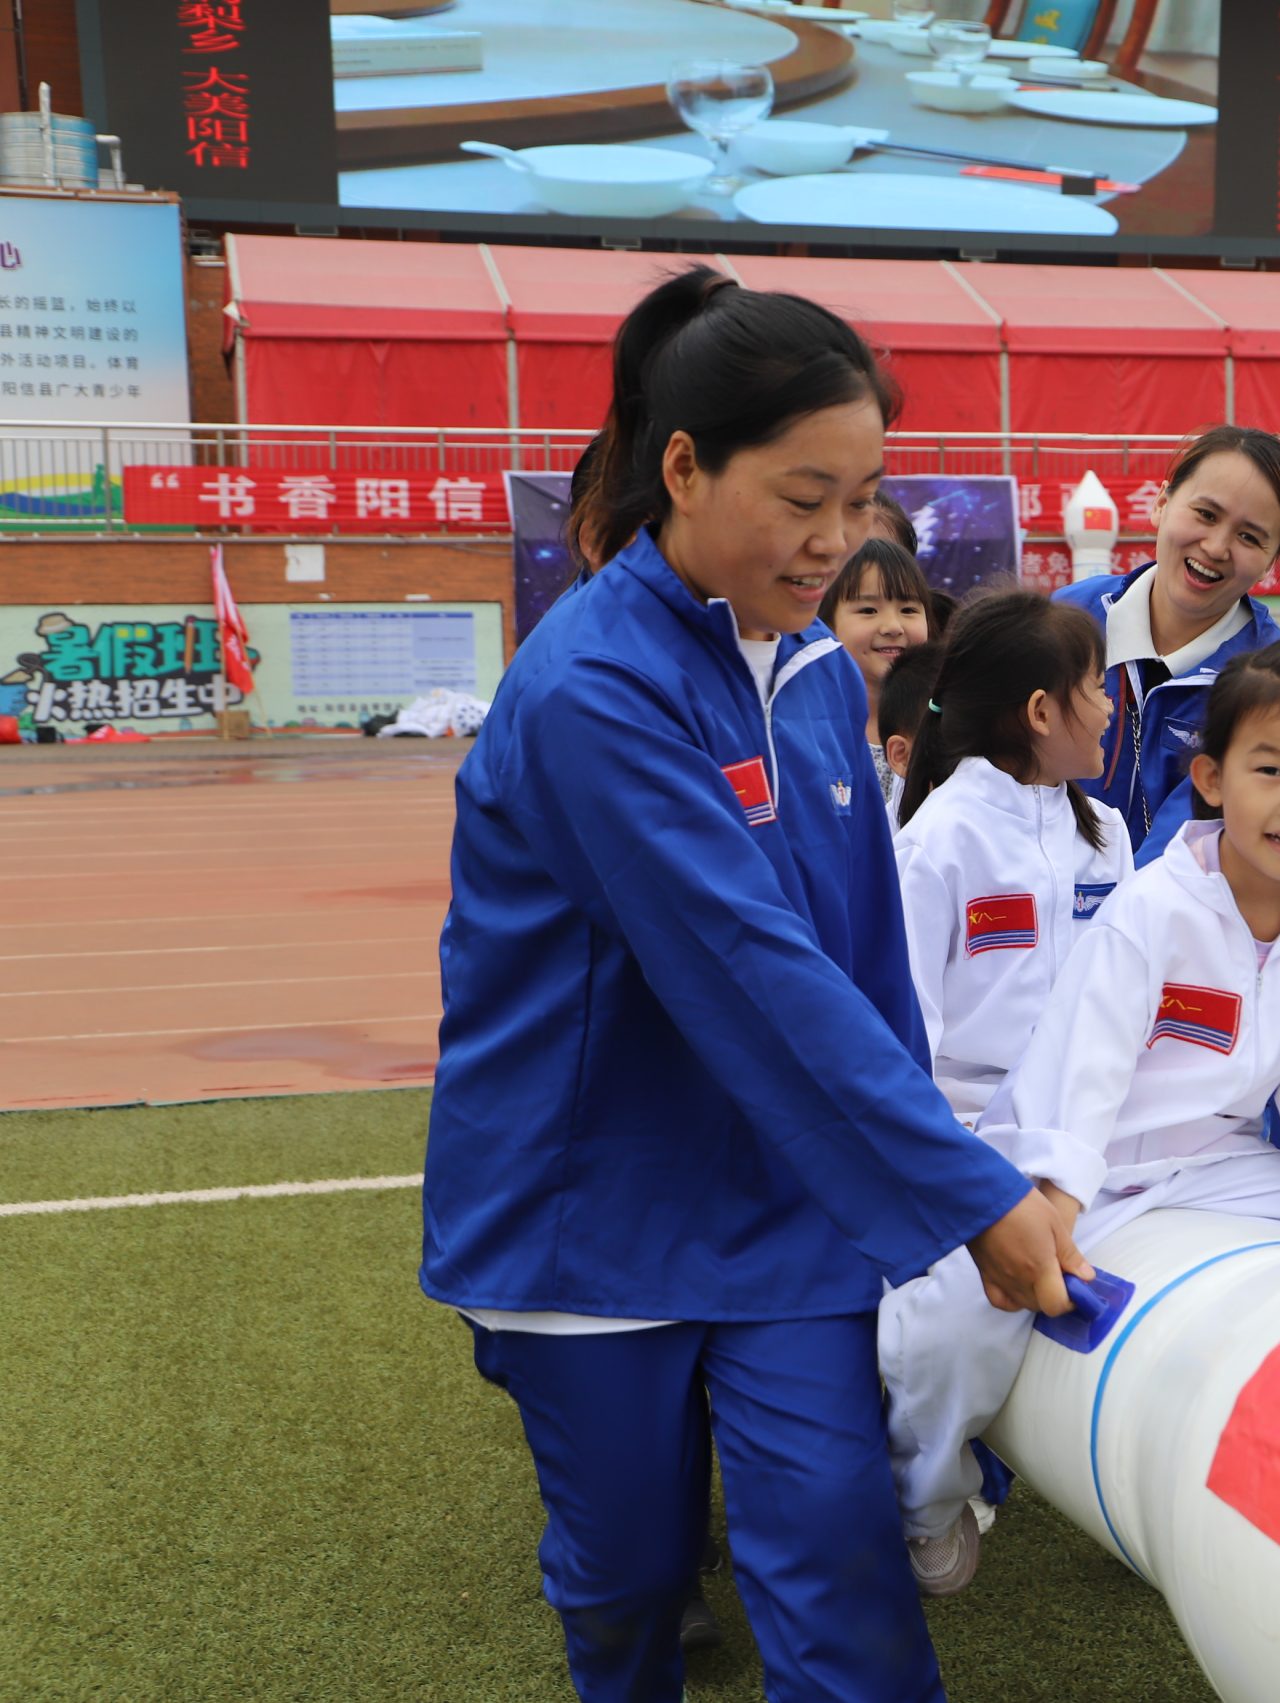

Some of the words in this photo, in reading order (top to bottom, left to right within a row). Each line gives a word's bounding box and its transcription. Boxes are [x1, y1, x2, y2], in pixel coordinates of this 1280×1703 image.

[181, 66, 250, 168] 大美阳信
[26, 673, 243, 723] 火热招生中
